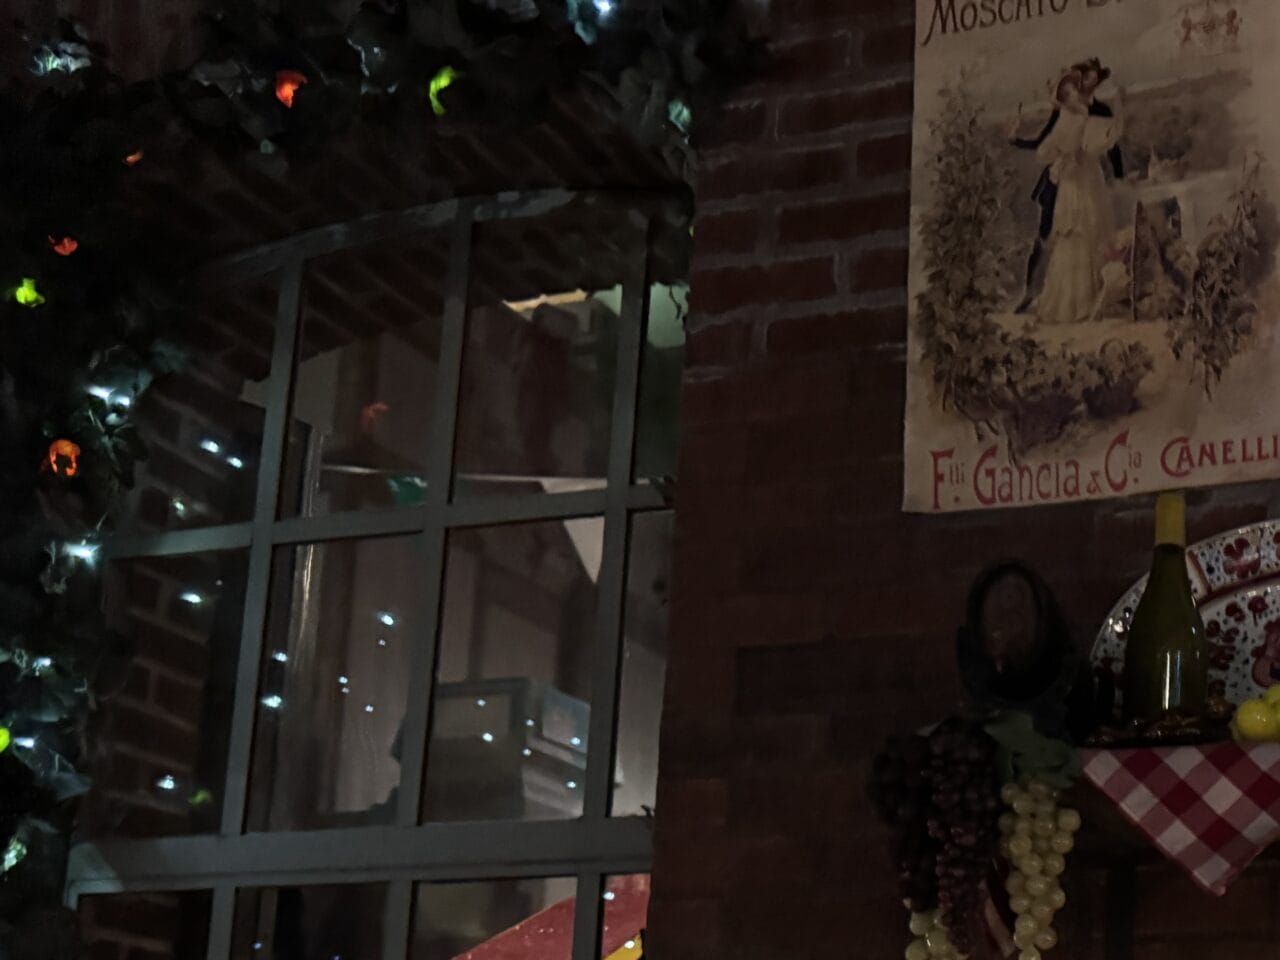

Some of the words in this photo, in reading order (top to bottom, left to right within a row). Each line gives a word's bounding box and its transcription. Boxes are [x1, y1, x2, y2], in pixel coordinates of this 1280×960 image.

[973, 444, 1081, 505] Gancia
[1086, 469, 1103, 495] &
[1160, 435, 1279, 478] CANELLI
